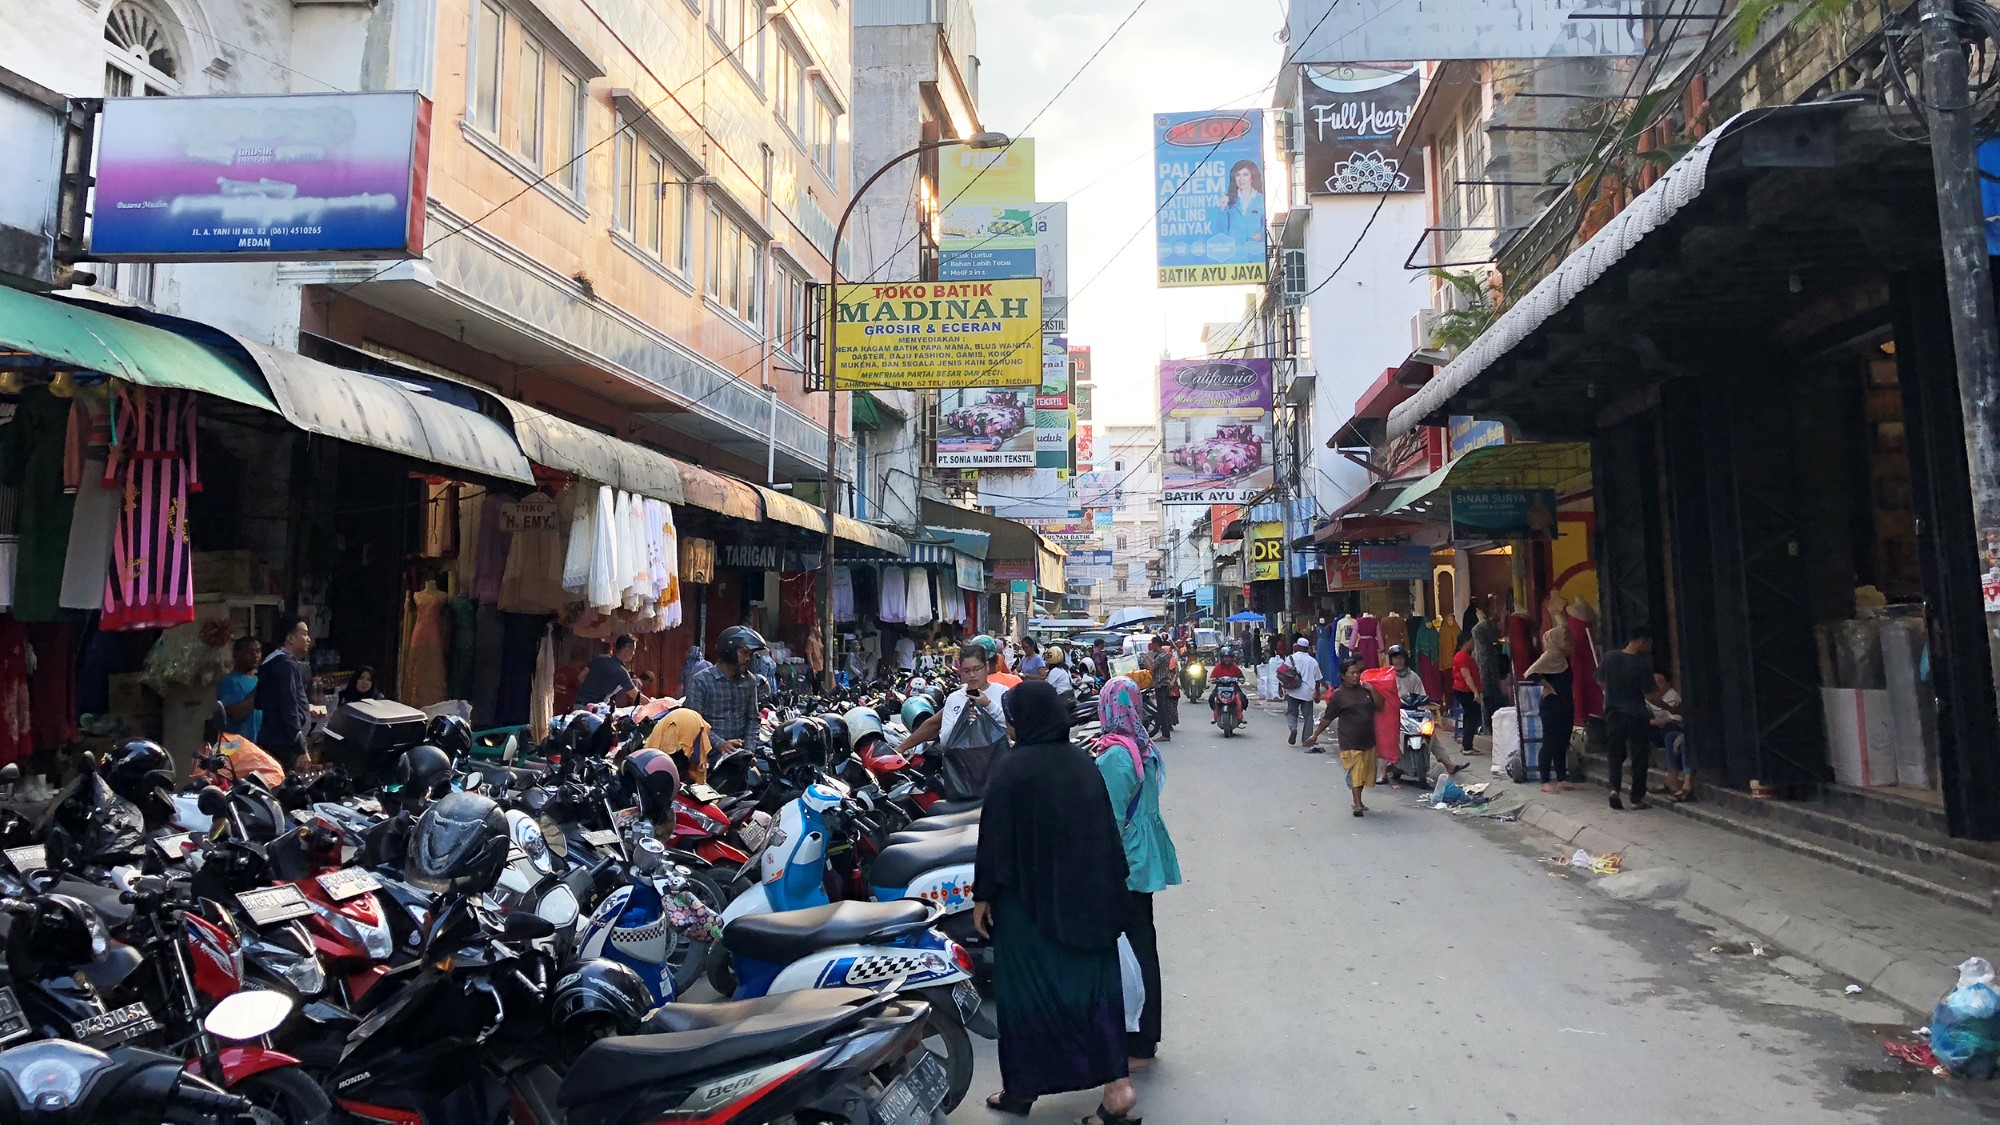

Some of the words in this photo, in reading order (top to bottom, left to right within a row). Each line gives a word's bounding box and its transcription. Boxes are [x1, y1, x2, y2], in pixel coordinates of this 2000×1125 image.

[1309, 102, 1360, 142] Full
[1358, 101, 1412, 135] Heart
[1159, 161, 1225, 179] PALING
[1160, 177, 1225, 196] ADEM
[1160, 208, 1206, 223] PALING
[203, 229, 212, 237] A.
[213, 228, 230, 236] YANI
[270, 227, 289, 236] (061)
[290, 226, 322, 235] 4510265
[1160, 221, 1212, 236] BANYAK
[239, 237, 271, 248] MEDAN
[1160, 268, 1197, 283] BATIK
[1200, 267, 1227, 281] AYU
[1230, 265, 1263, 280] JAYA
[872, 285, 926, 300] TOKO
[933, 283, 993, 298] BATIK
[838, 297, 1028, 323] MADINAH
[864, 323, 921, 335] GROSIR
[926, 322, 936, 333] &
[941, 322, 1002, 333] ECERAN
[860, 371, 904, 379] MENERIMA
[1175, 364, 1254, 390] California
[1036, 397, 1063, 406] TEKSTIL
[938, 455, 948, 464] PT.
[949, 455, 971, 464] SONIA
[973, 454, 1003, 463] MANDIRI
[1004, 454, 1033, 463] TEKSTIL
[965, 471, 976, 479] PT.
[1164, 491, 1204, 501] BATIK
[1208, 491, 1235, 501] AYU
[1456, 494, 1489, 504] SINAR
[1491, 493, 1527, 503] SURYA
[726, 545, 776, 567] TARIGAN
[1361, 546, 1405, 562] NOVI
[338, 1071, 371, 1089] HONDA
